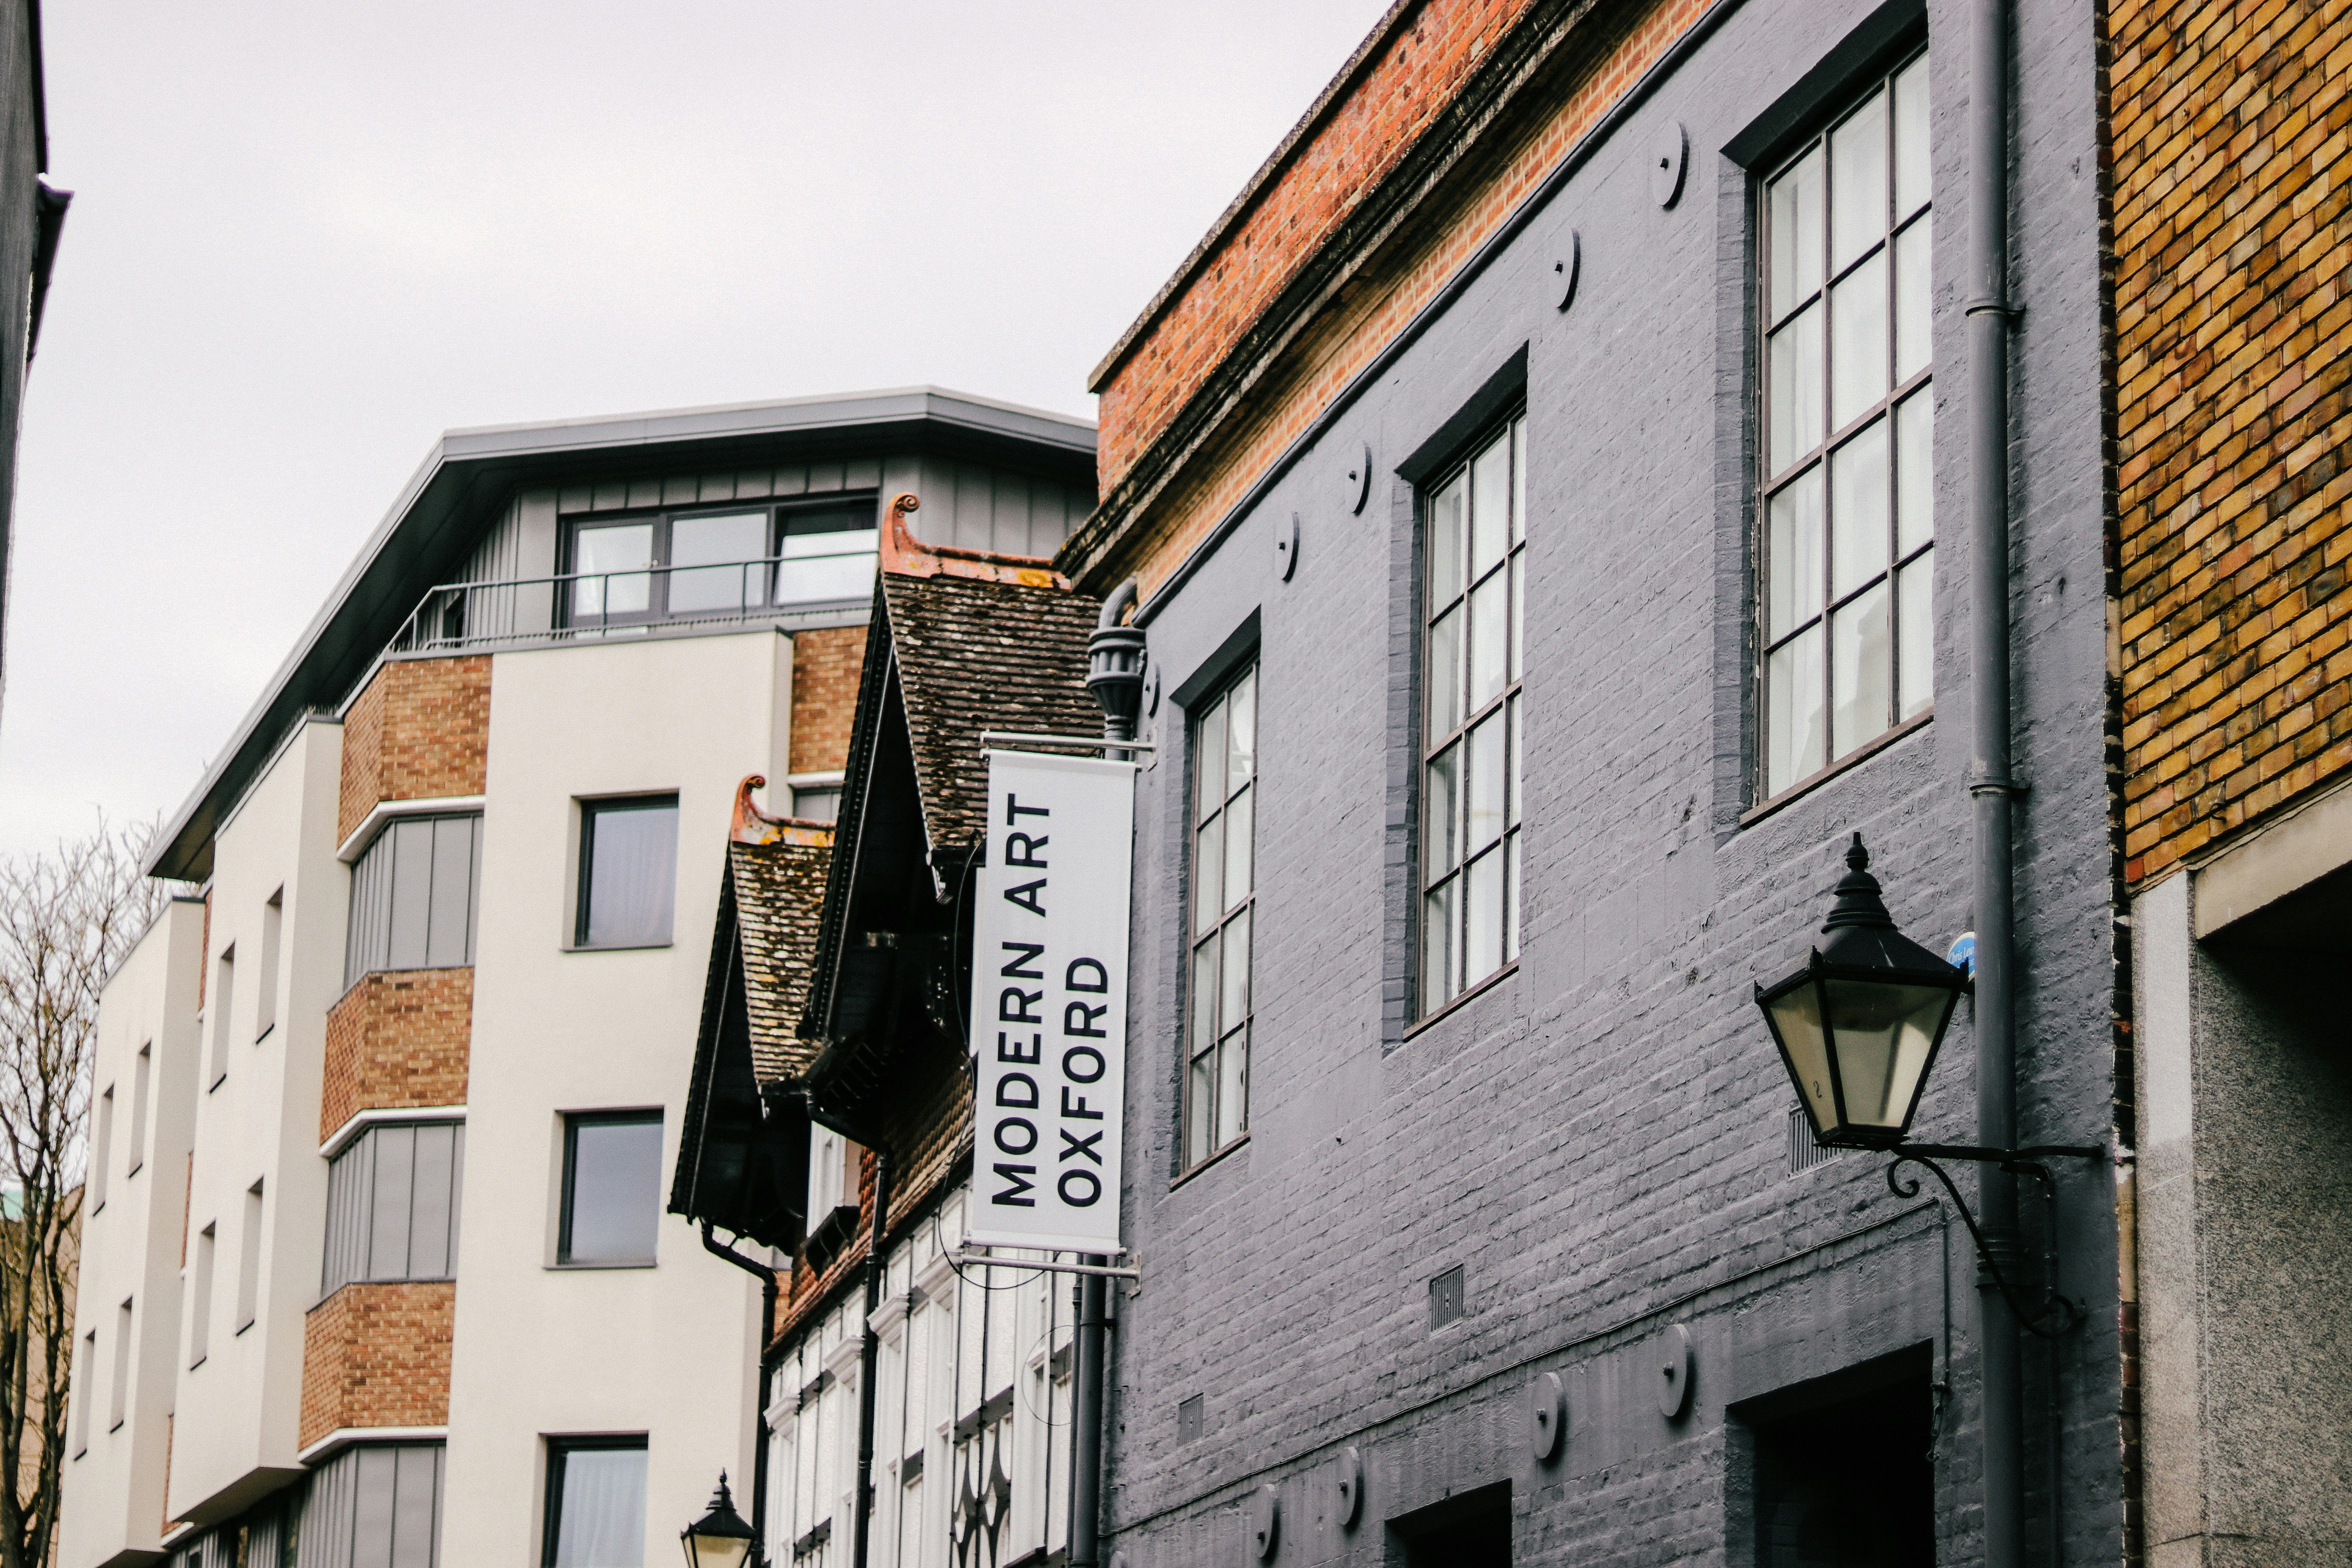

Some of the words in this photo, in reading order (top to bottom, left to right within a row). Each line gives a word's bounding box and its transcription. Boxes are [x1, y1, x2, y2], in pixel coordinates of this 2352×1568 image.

[1004, 793, 1050, 917] ART
[991, 941, 1044, 1207] MODERN
[1057, 957, 1108, 1207] OXFORD
